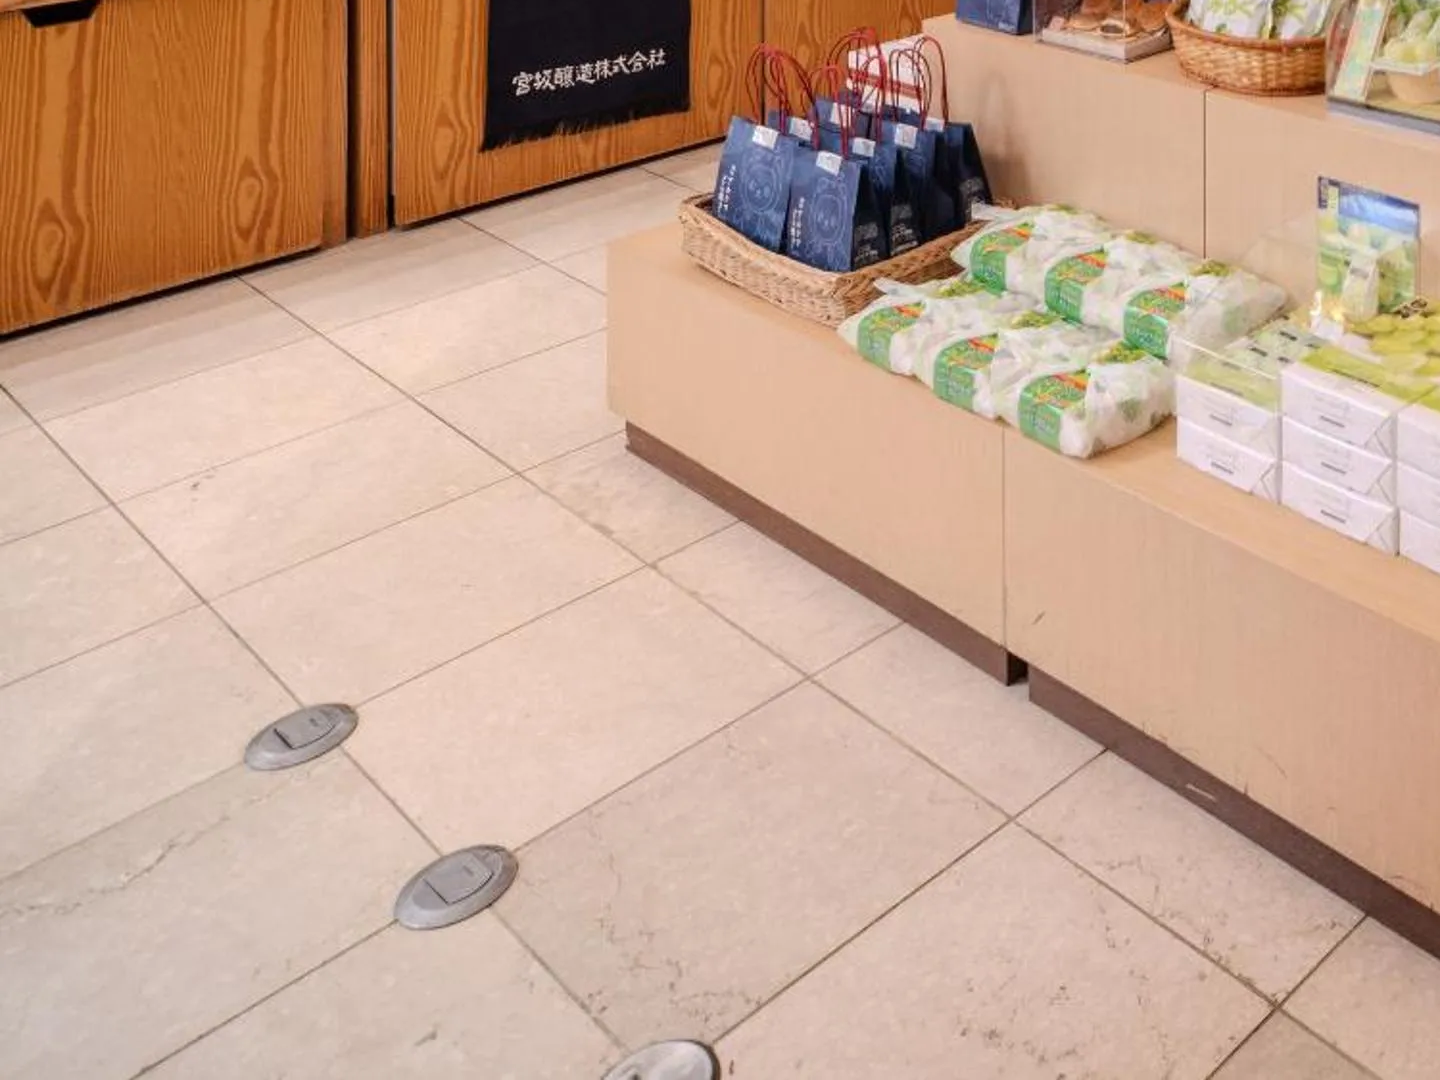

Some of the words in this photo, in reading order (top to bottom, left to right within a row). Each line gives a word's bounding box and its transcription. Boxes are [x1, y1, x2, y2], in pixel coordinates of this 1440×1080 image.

[511, 47, 667, 97] 宮坂醸造株式会社
